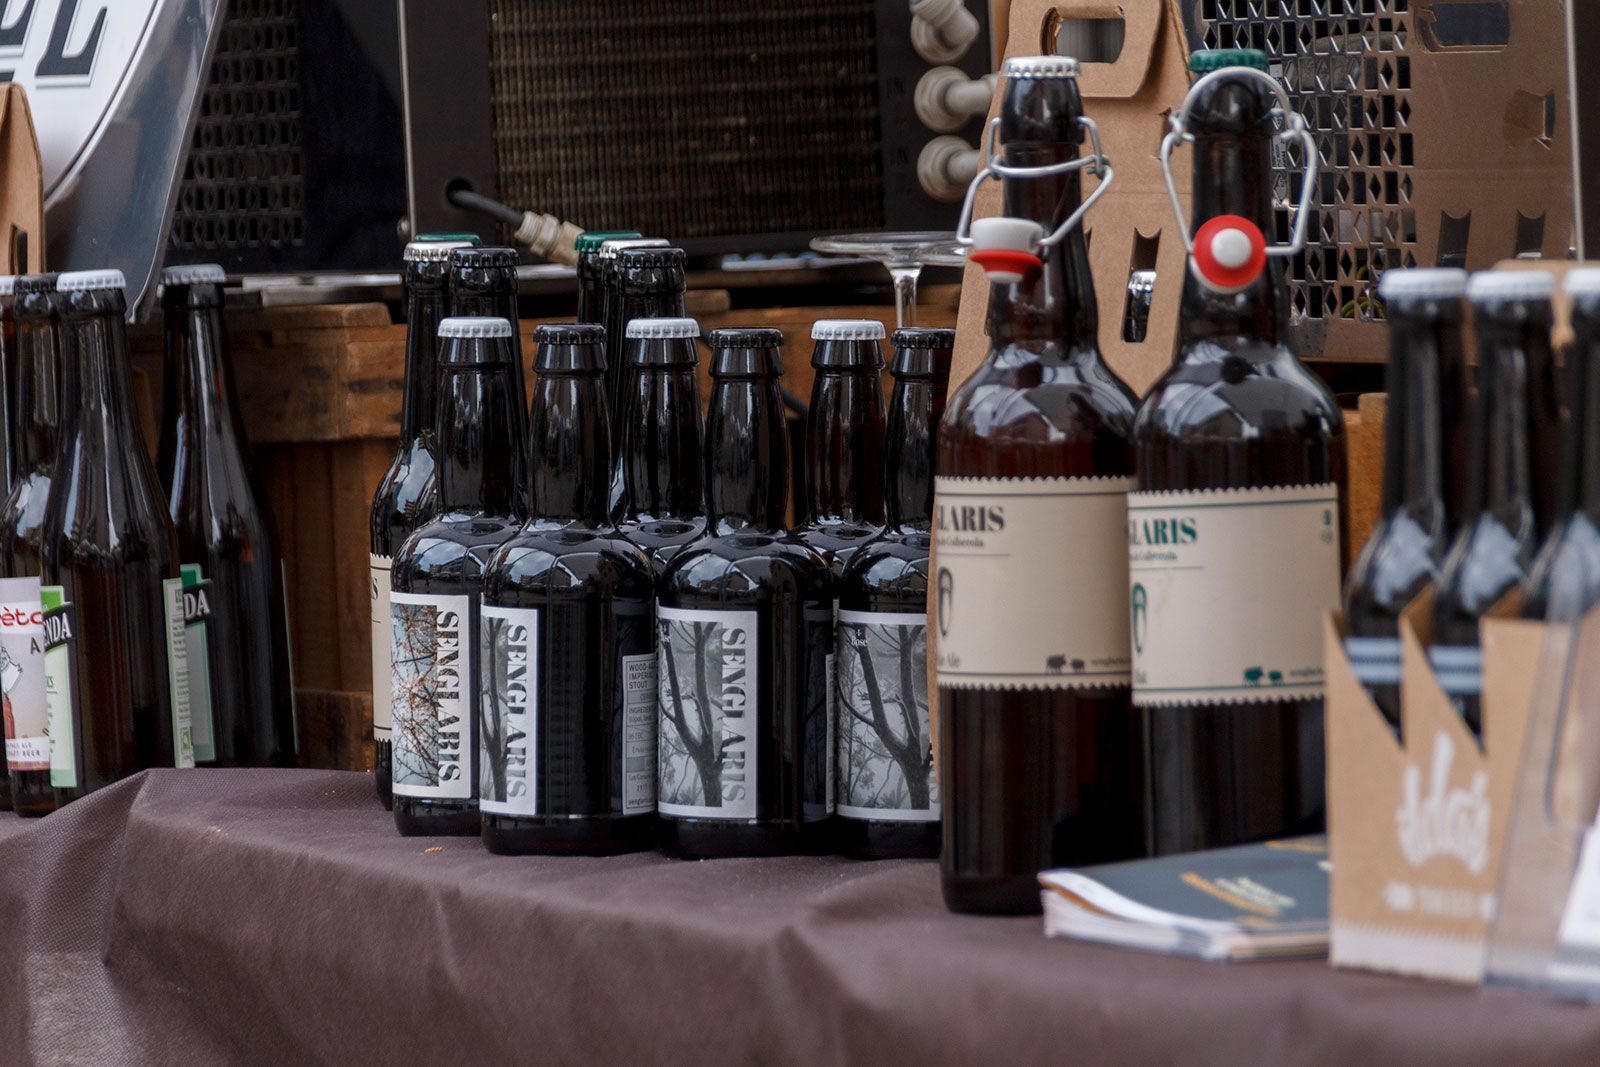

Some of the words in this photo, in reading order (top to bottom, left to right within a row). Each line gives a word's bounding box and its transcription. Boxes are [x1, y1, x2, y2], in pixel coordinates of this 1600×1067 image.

[437, 610, 461, 782] SENGLARIS
[507, 624, 528, 798] SENGLARIS
[721, 626, 746, 803] SENGLARIS
